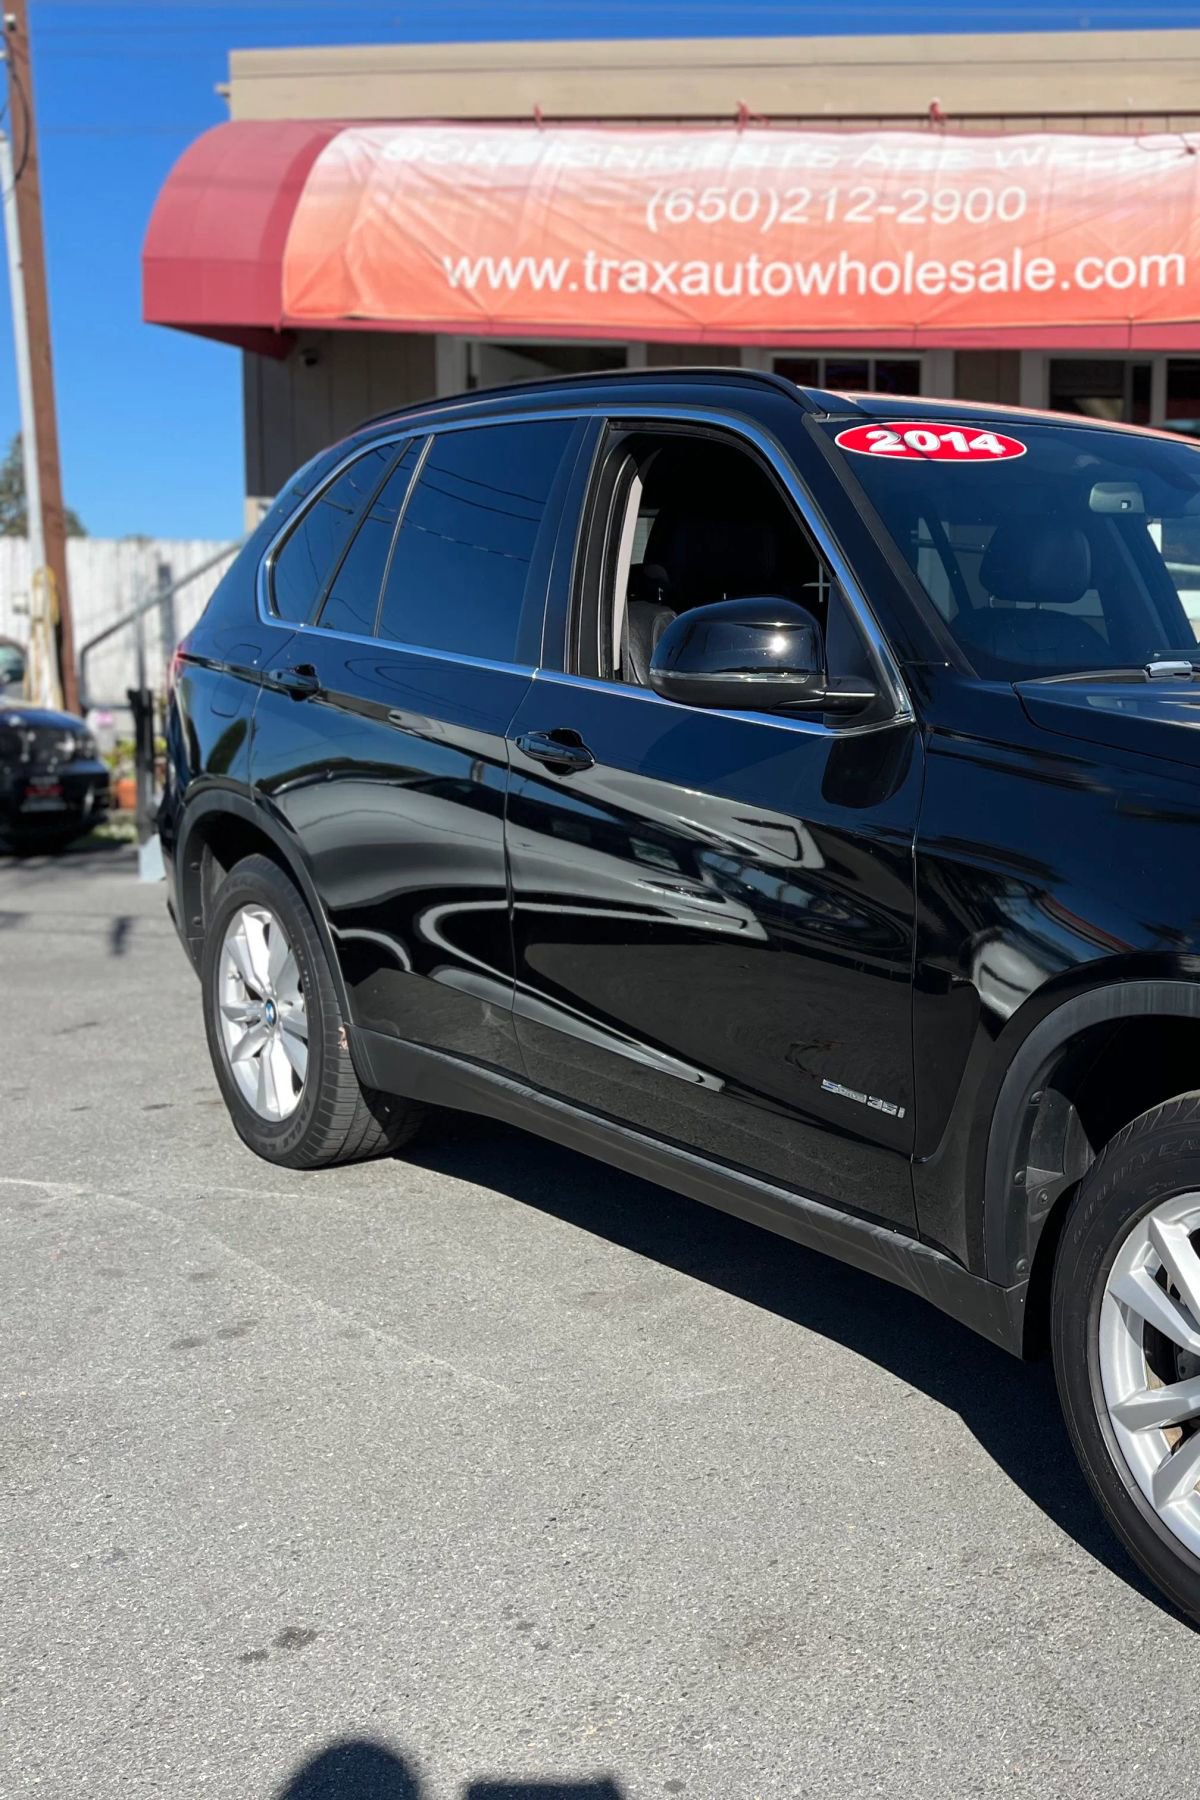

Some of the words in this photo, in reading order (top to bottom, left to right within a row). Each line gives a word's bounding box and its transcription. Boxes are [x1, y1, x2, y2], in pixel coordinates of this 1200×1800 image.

[645, 186, 1027, 232] (650)212-2900
[442, 246, 1185, 297] www.traxautowholesale.com
[865, 430, 1007, 456] 2014
